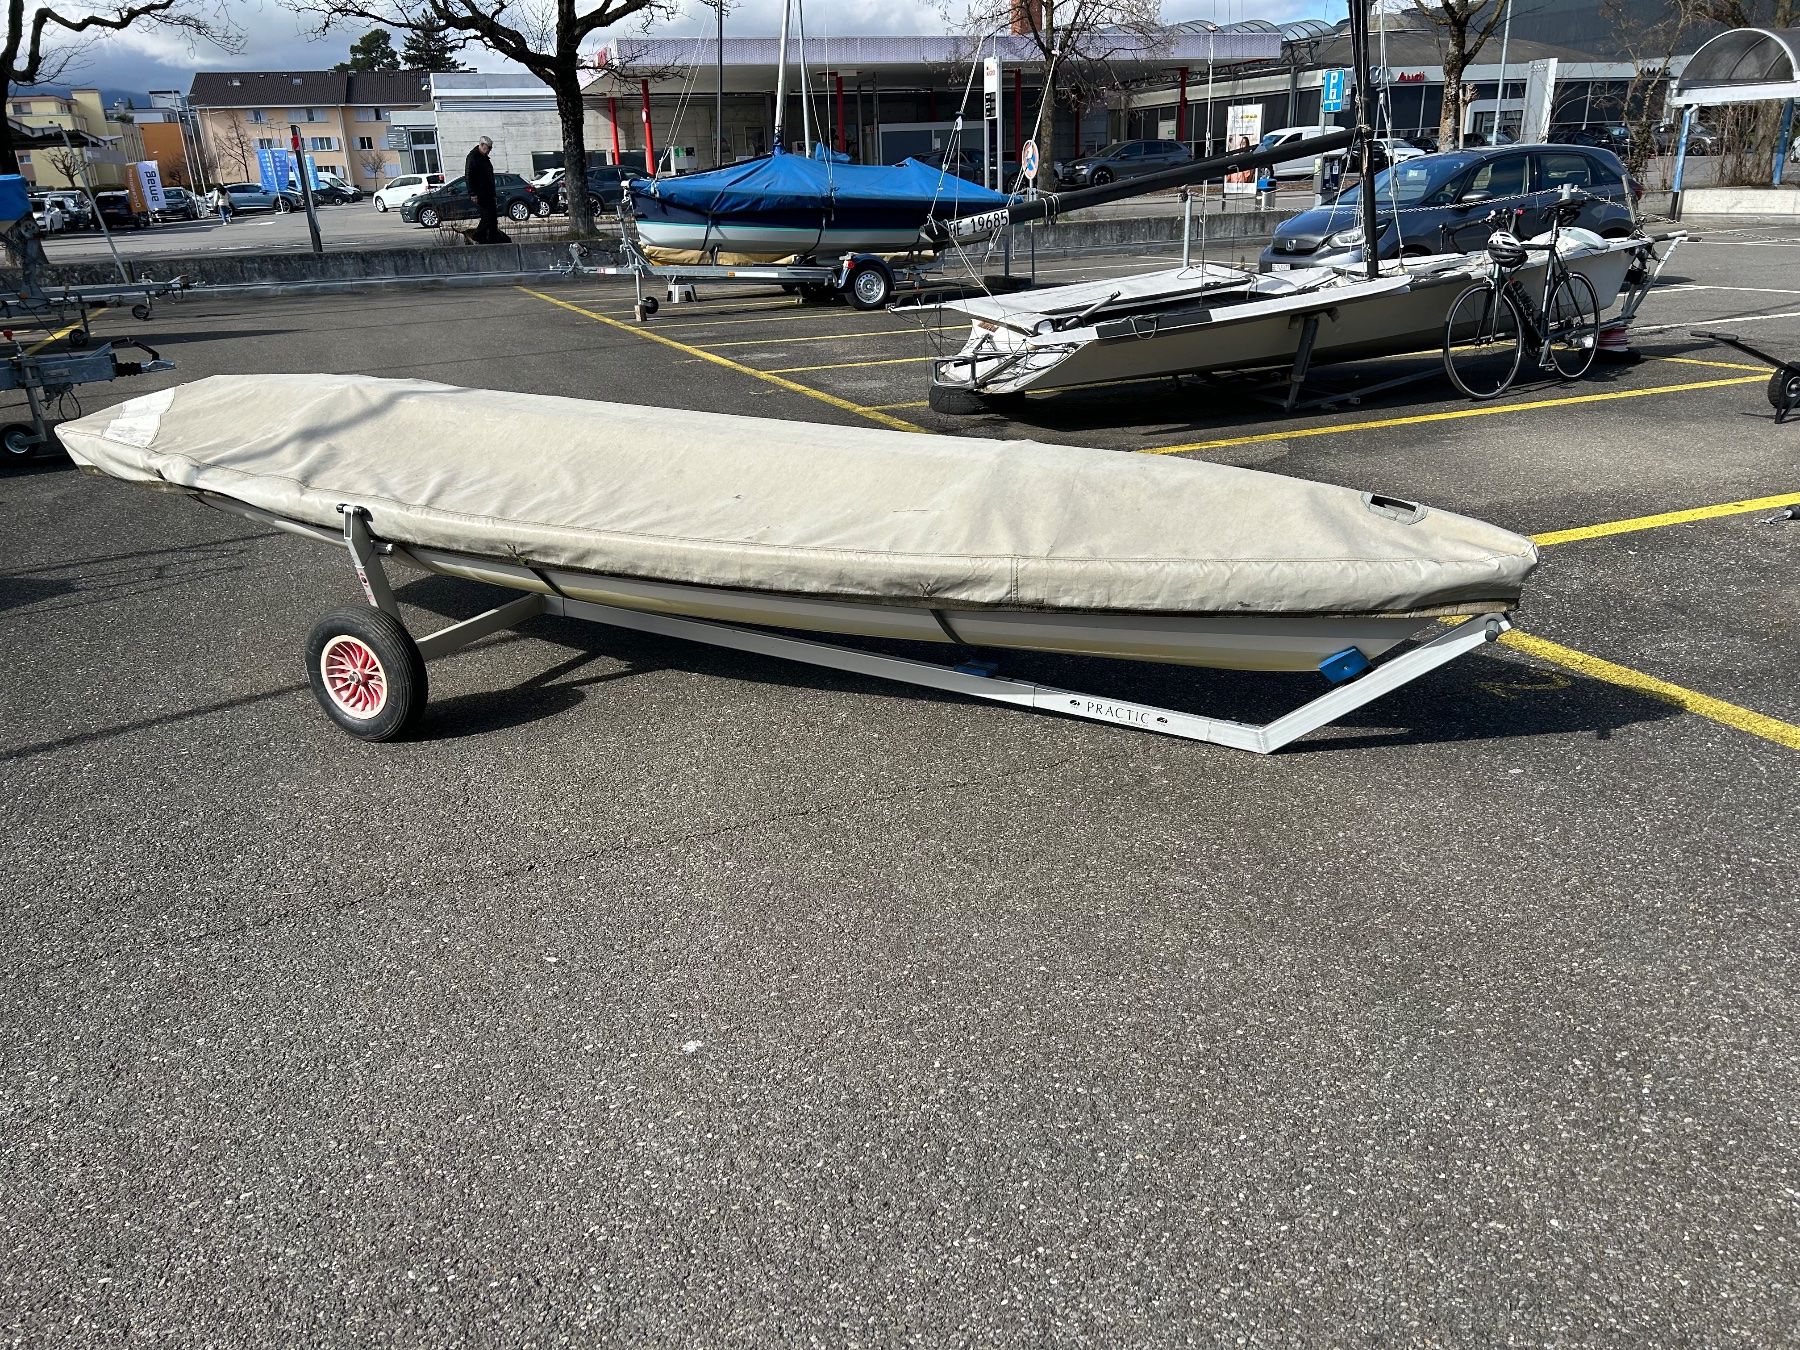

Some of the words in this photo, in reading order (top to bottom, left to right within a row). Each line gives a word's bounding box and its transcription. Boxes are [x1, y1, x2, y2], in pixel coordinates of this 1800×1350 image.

[1330, 72, 1338, 89] P
[1397, 71, 1425, 81] Audi
[144, 170, 159, 202] amag
[970, 210, 1008, 233] 19685
[1087, 701, 1150, 724] PRACTIC
